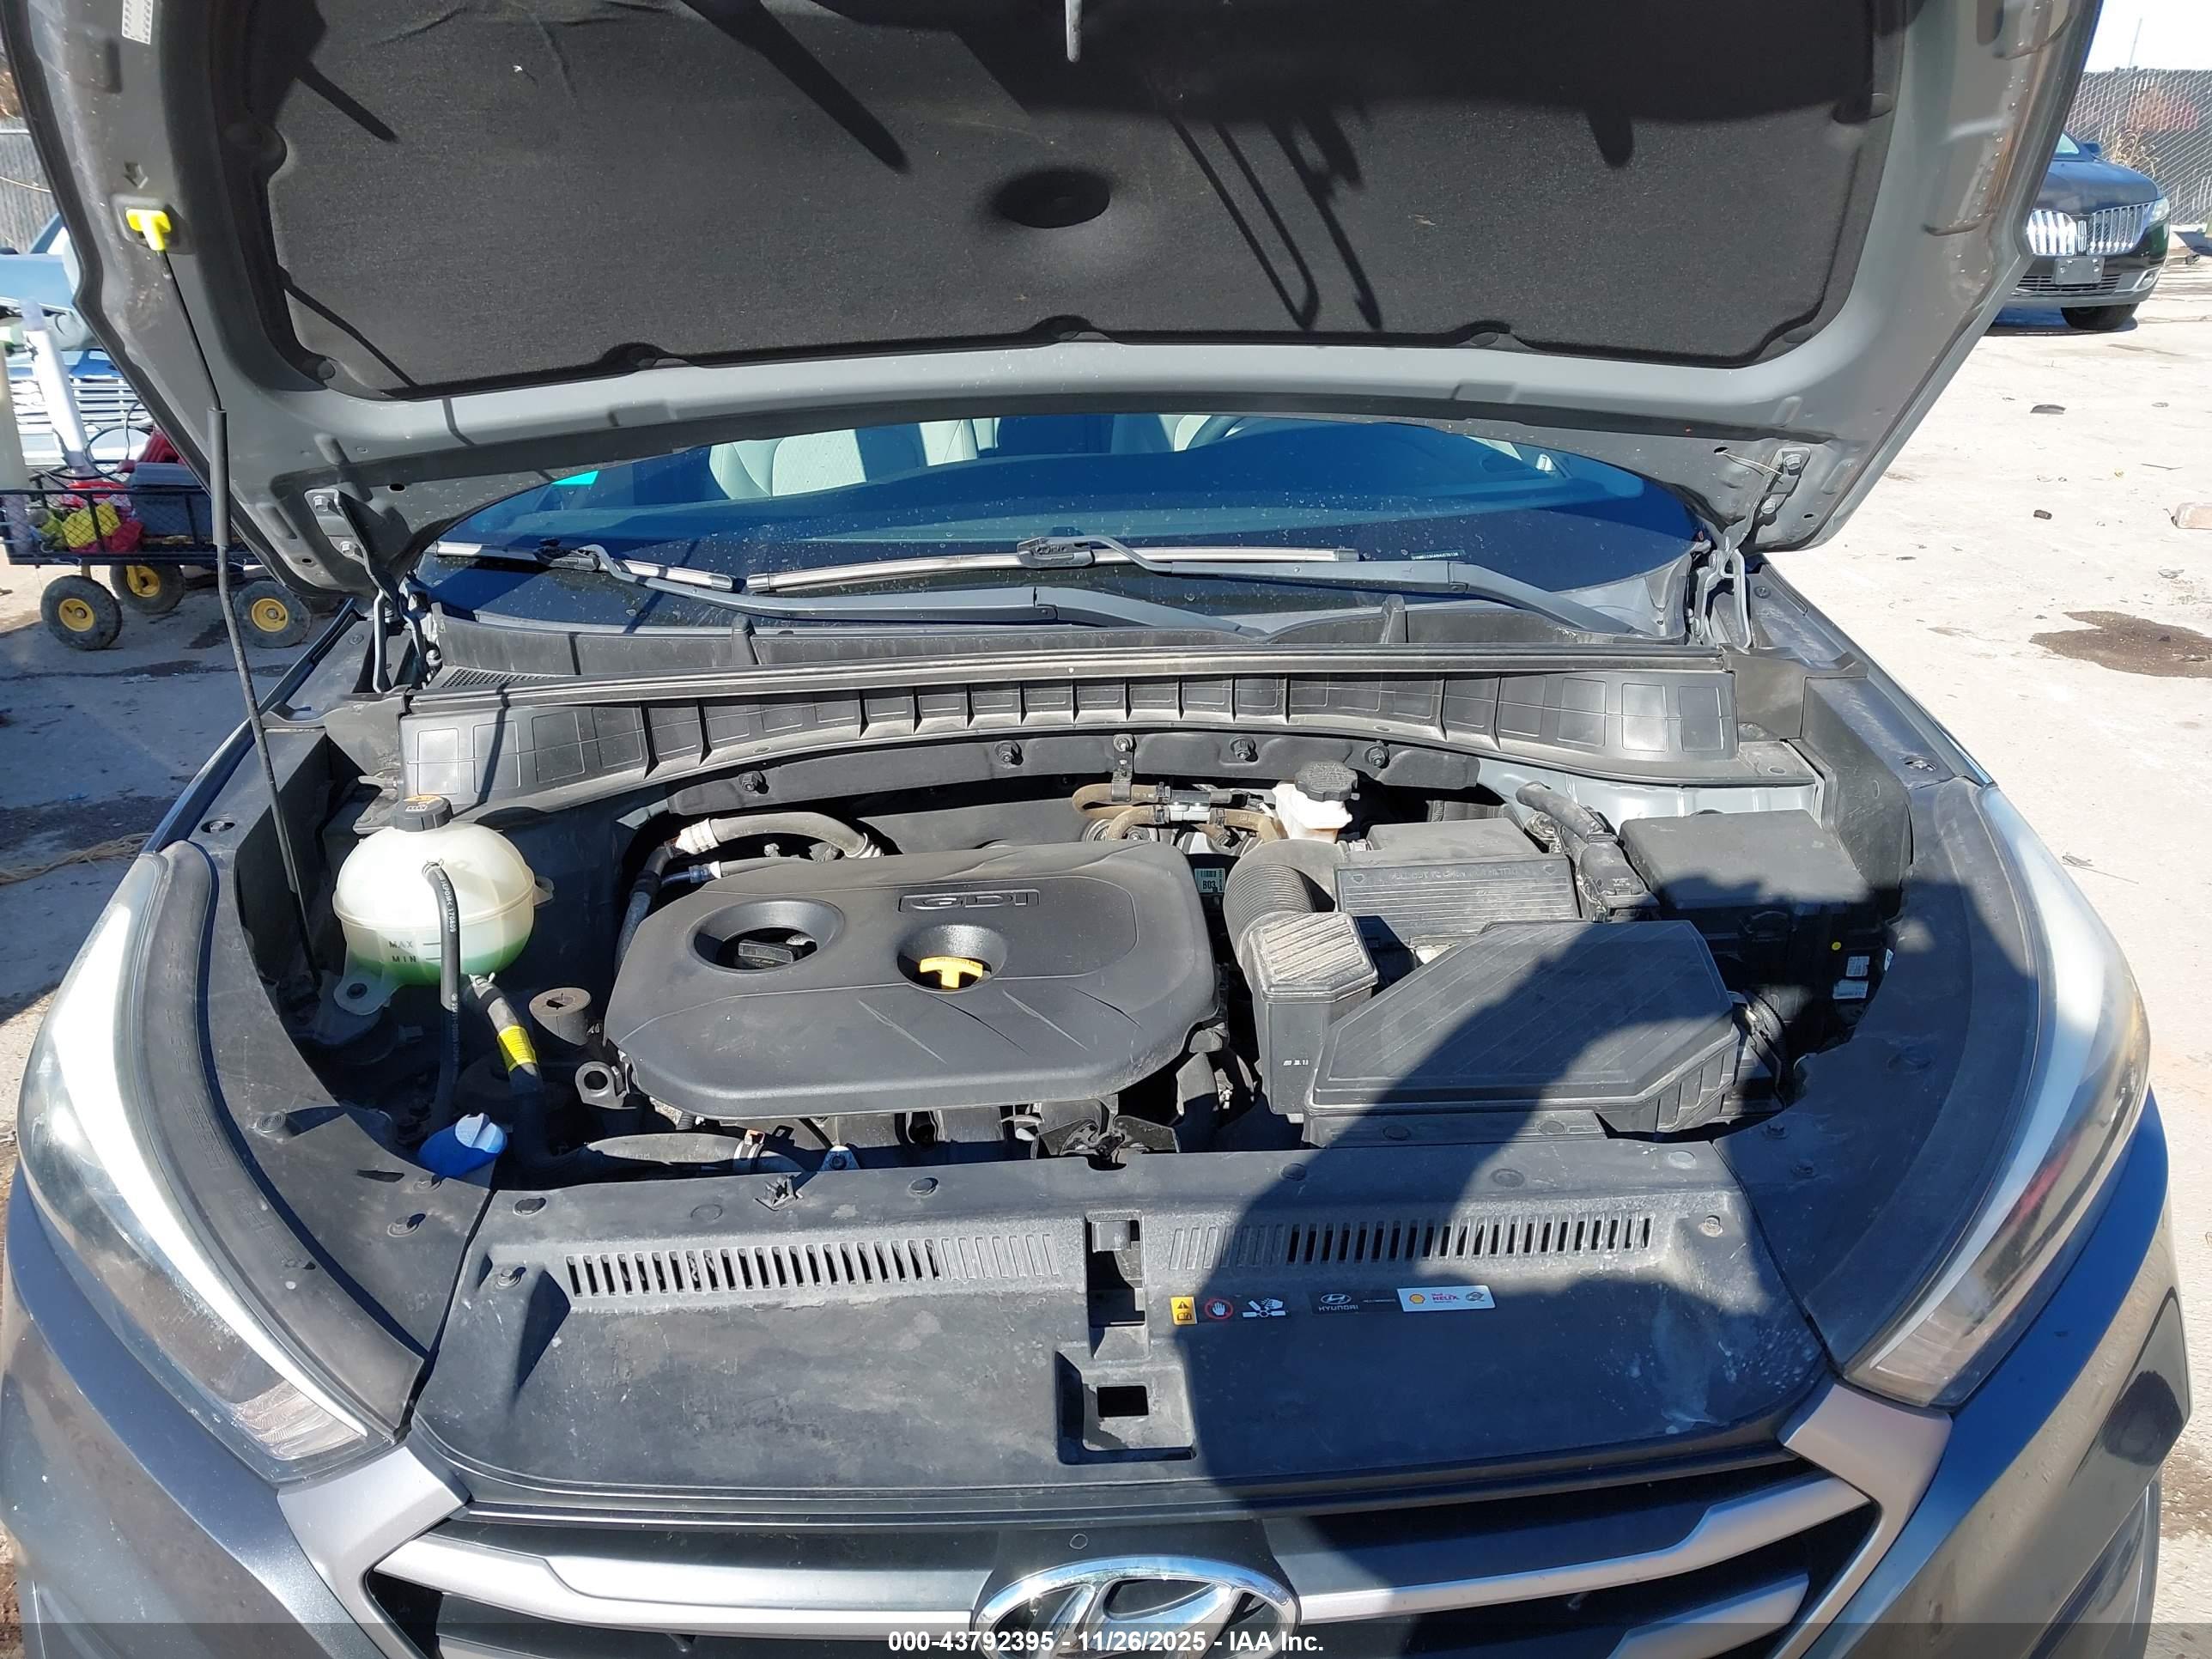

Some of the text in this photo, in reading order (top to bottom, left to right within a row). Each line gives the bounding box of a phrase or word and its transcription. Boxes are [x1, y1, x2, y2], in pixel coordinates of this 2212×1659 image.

[909, 892, 1030, 910] GDI
[388, 940, 413, 949] MAX
[1318, 1304, 1359, 1313] HYUNDAI
